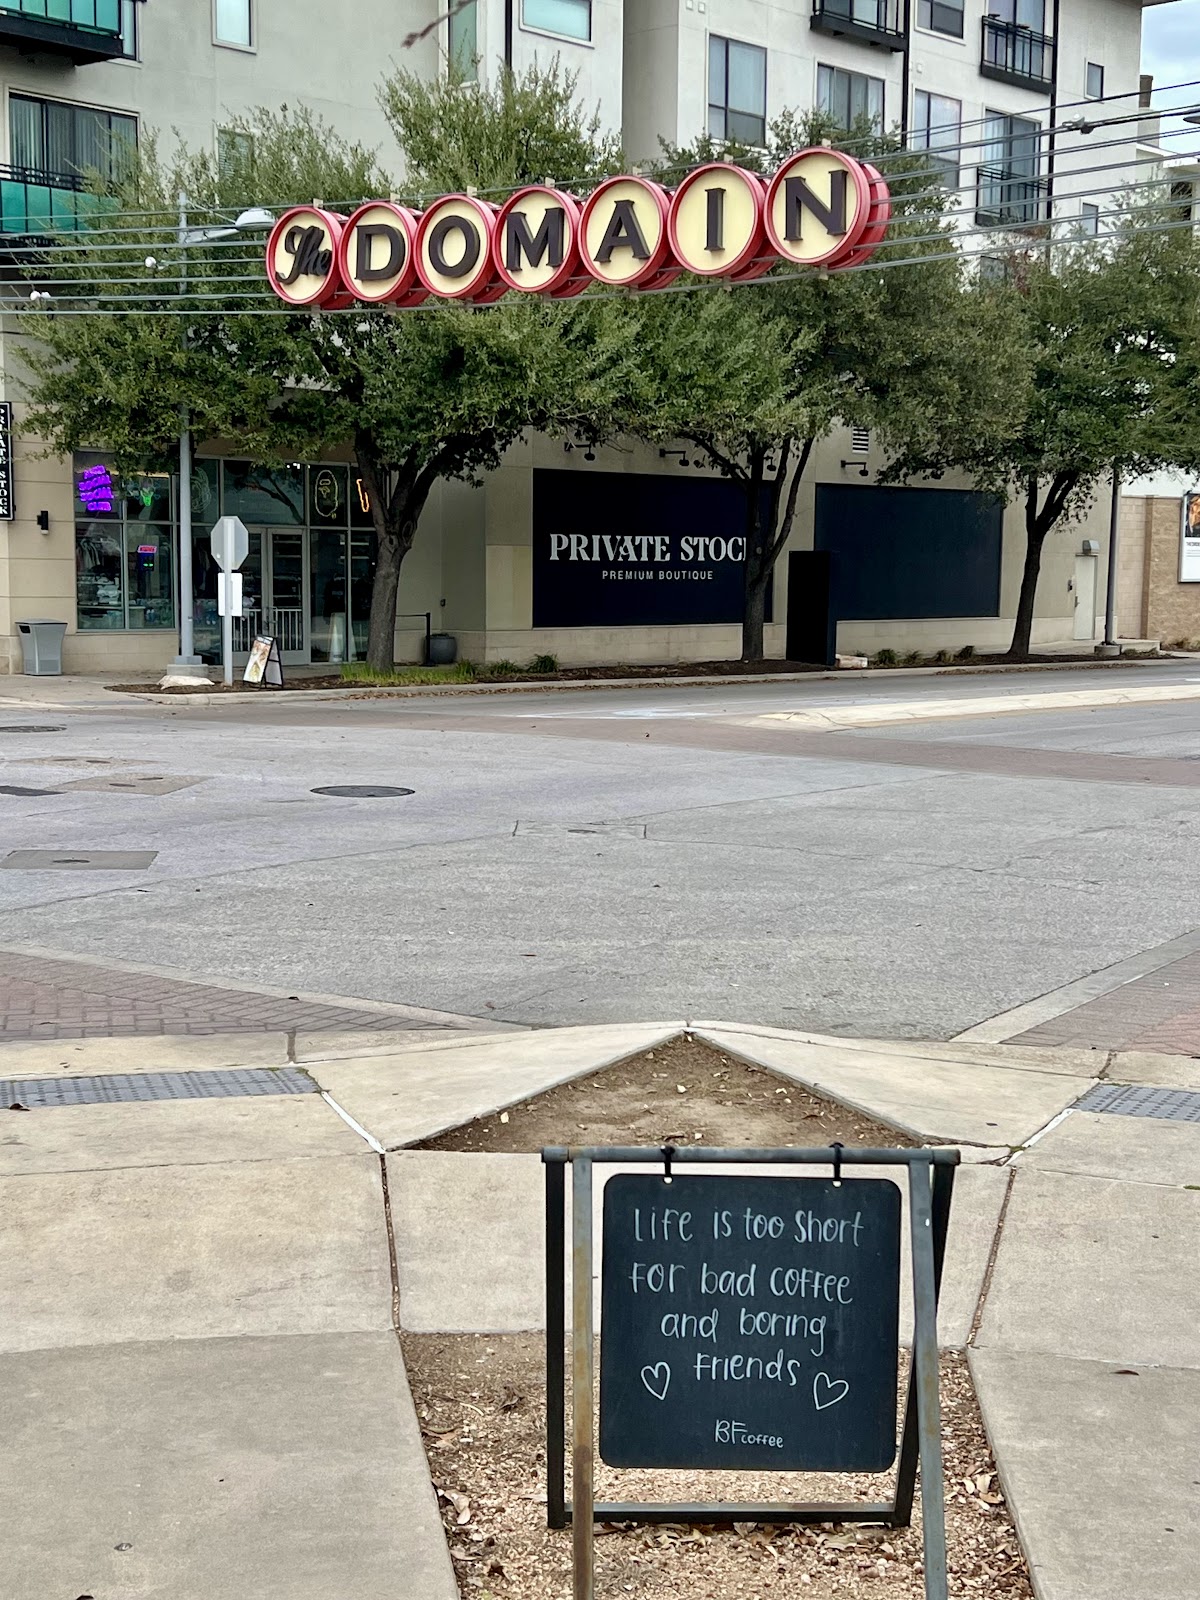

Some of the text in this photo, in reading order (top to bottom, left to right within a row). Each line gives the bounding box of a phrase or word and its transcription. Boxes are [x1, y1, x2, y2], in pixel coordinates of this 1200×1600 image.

[275, 168, 849, 285] The DOMAIN
[549, 533, 747, 562] PRIVATE STOC
[602, 570, 714, 580] PREMIUM BOUTIQUE
[713, 1206, 732, 1240] is
[743, 1207, 785, 1241] too
[700, 1262, 757, 1297] bad
[661, 1308, 827, 1357] and boring
